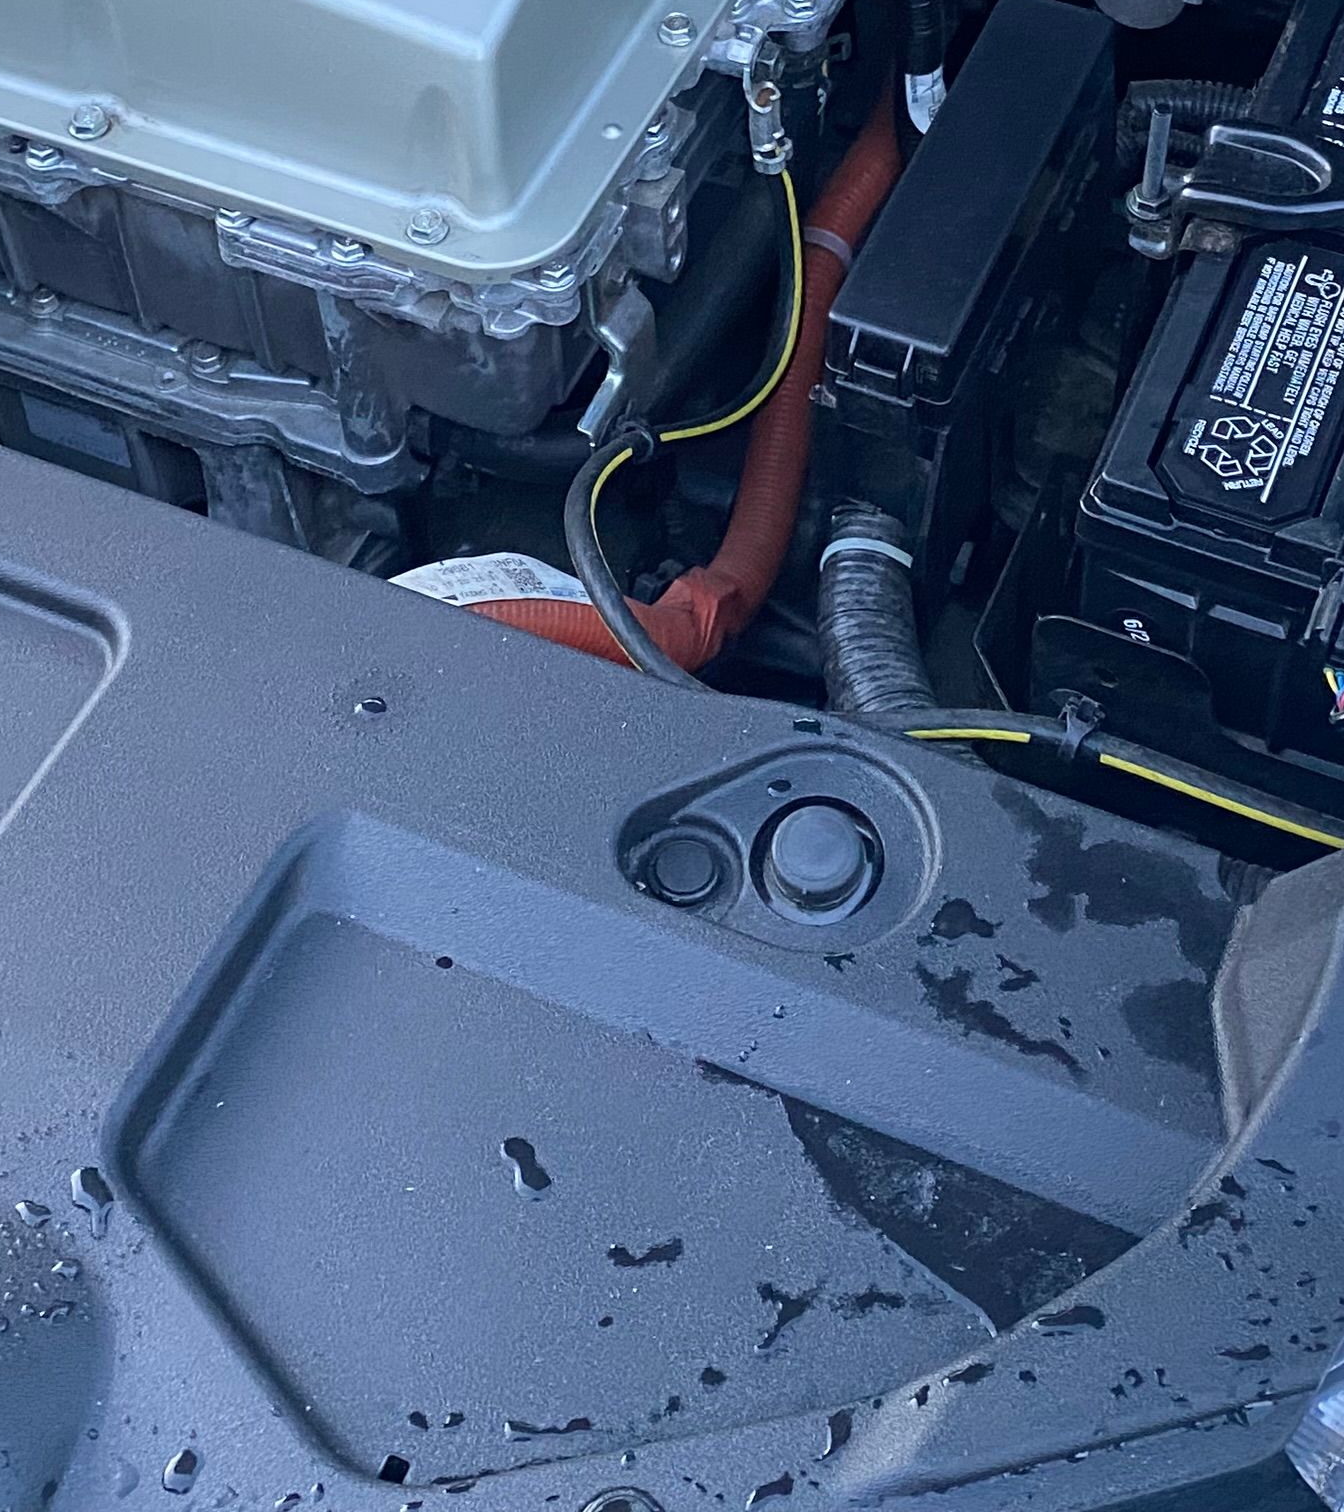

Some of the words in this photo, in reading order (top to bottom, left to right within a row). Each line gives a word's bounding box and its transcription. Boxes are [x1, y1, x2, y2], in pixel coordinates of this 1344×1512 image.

[1258, 262, 1274, 279] NOT
[1270, 290, 1285, 307] FOR
[1281, 290, 1308, 329] MEDICAL
[1300, 294, 1321, 319] WITH
[1263, 304, 1279, 324] SAFE
[1311, 298, 1334, 328] FLUSH
[1272, 326, 1293, 352] HELP
[1287, 316, 1312, 350] WATER.
[1302, 324, 1324, 351] EYES
[1263, 348, 1285, 374] FAST
[1281, 347, 1300, 369] GET
[1319, 346, 1337, 369] KEEP
[1330, 356, 1344, 370] OF
[1281, 347, 1315, 406] IMMEDIATELY
[1312, 365, 1329, 387] VENT
[1325, 368, 1340, 385] THE
[1304, 384, 1322, 407] CAPS
[1315, 383, 1334, 410] REACH
[1296, 404, 1314, 429] TIGHT
[1311, 406, 1325, 421] OF
[1183, 416, 1208, 458] RECYCLE
[1259, 418, 1284, 441] LEAD
[1289, 426, 1306, 446] AND
[1296, 417, 1321, 458] CHILDREN
[1220, 478, 1264, 491] RETURN
[1122, 618, 1150, 644] 6/2
